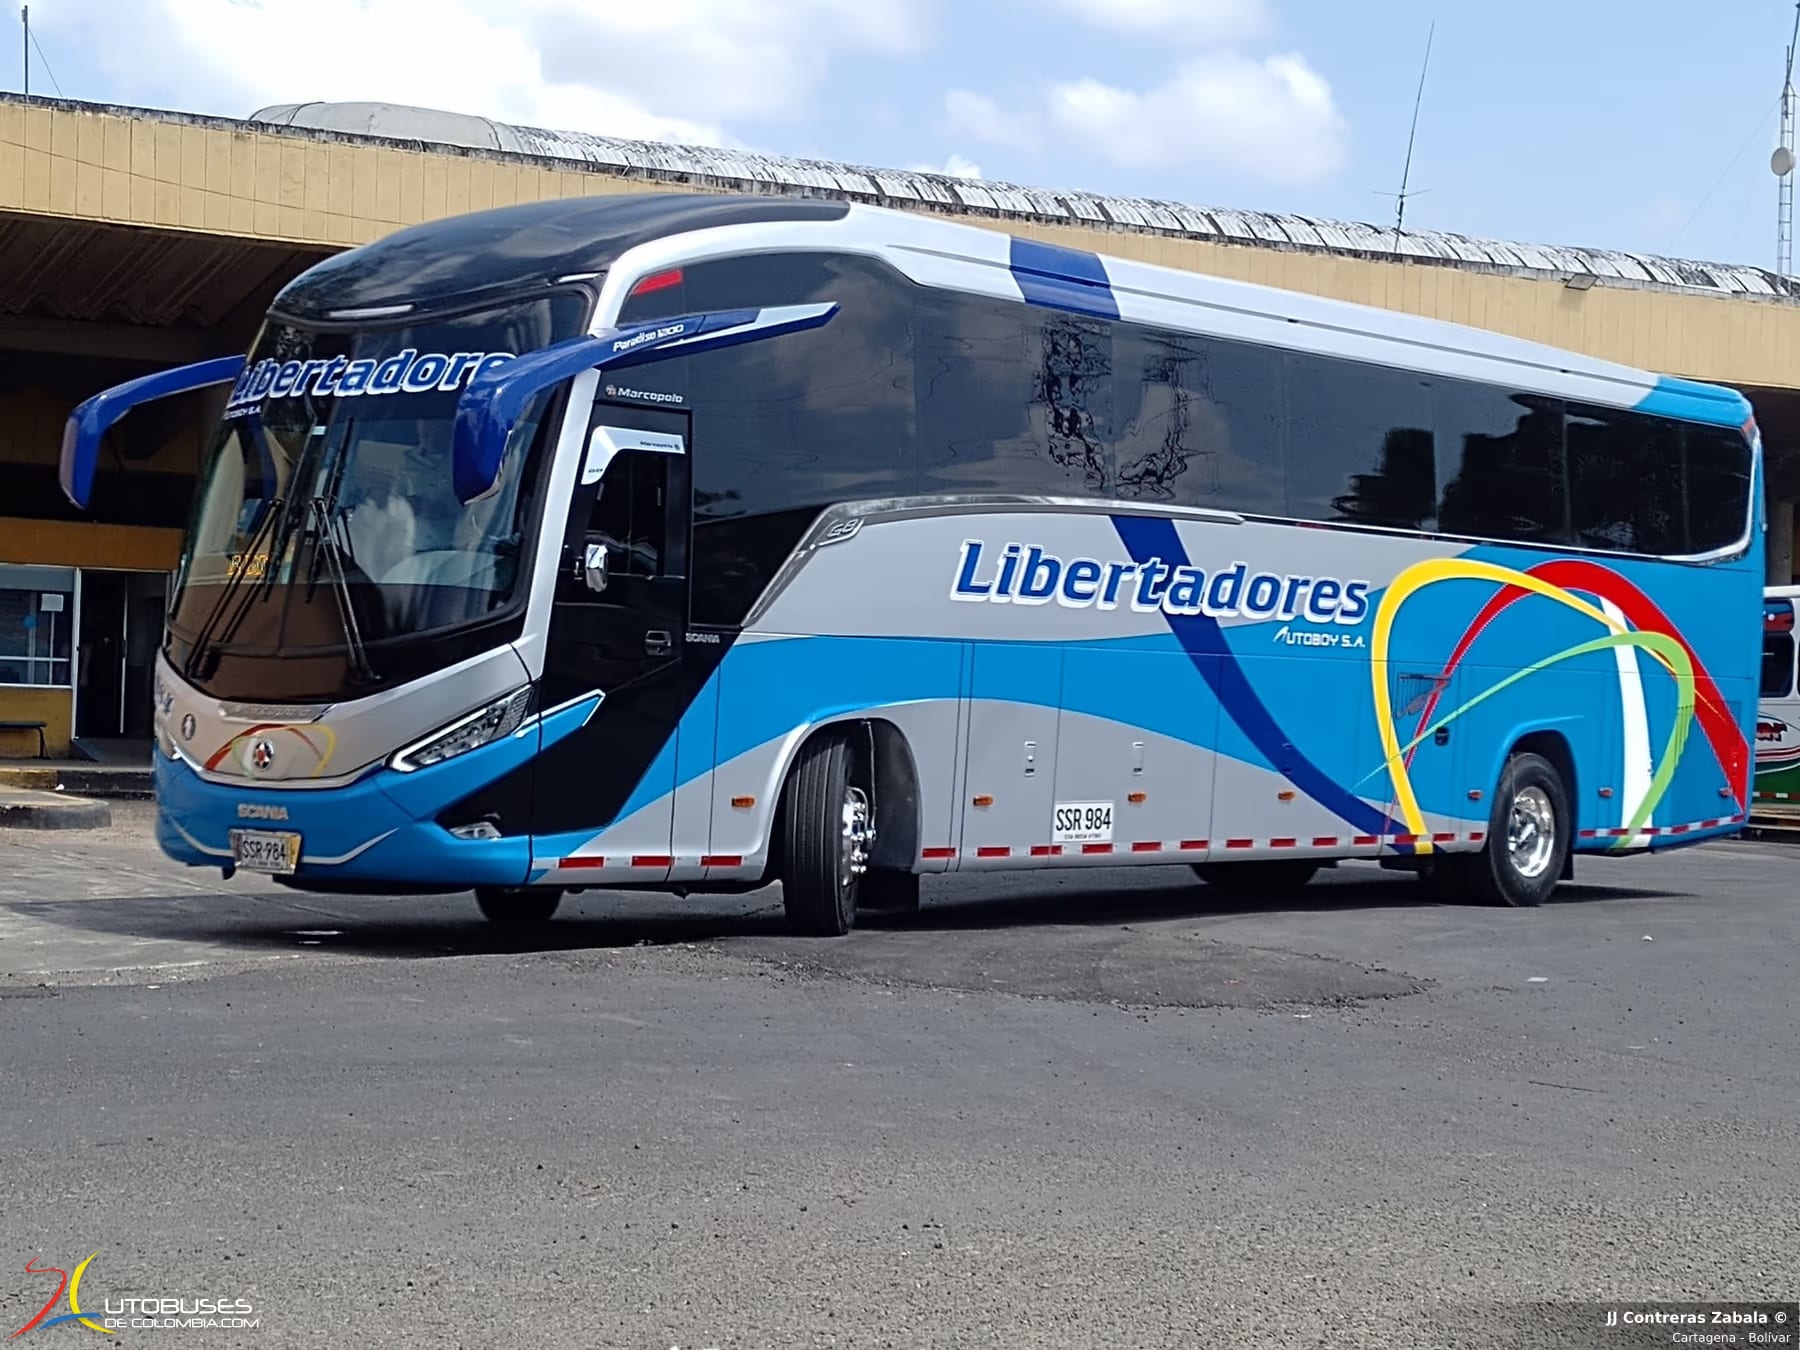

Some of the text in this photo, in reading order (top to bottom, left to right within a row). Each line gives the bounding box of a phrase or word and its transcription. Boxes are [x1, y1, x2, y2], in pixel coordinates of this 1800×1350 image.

[613, 324, 684, 352] Paradiso 1200
[617, 387, 684, 403] Marcopolo
[950, 539, 1370, 625] Libertadores
[685, 632, 720, 643] SCANIA
[1272, 626, 1339, 646] AUTOBOY
[237, 803, 289, 820] SCANIA
[1055, 807, 1112, 831] SSR 984
